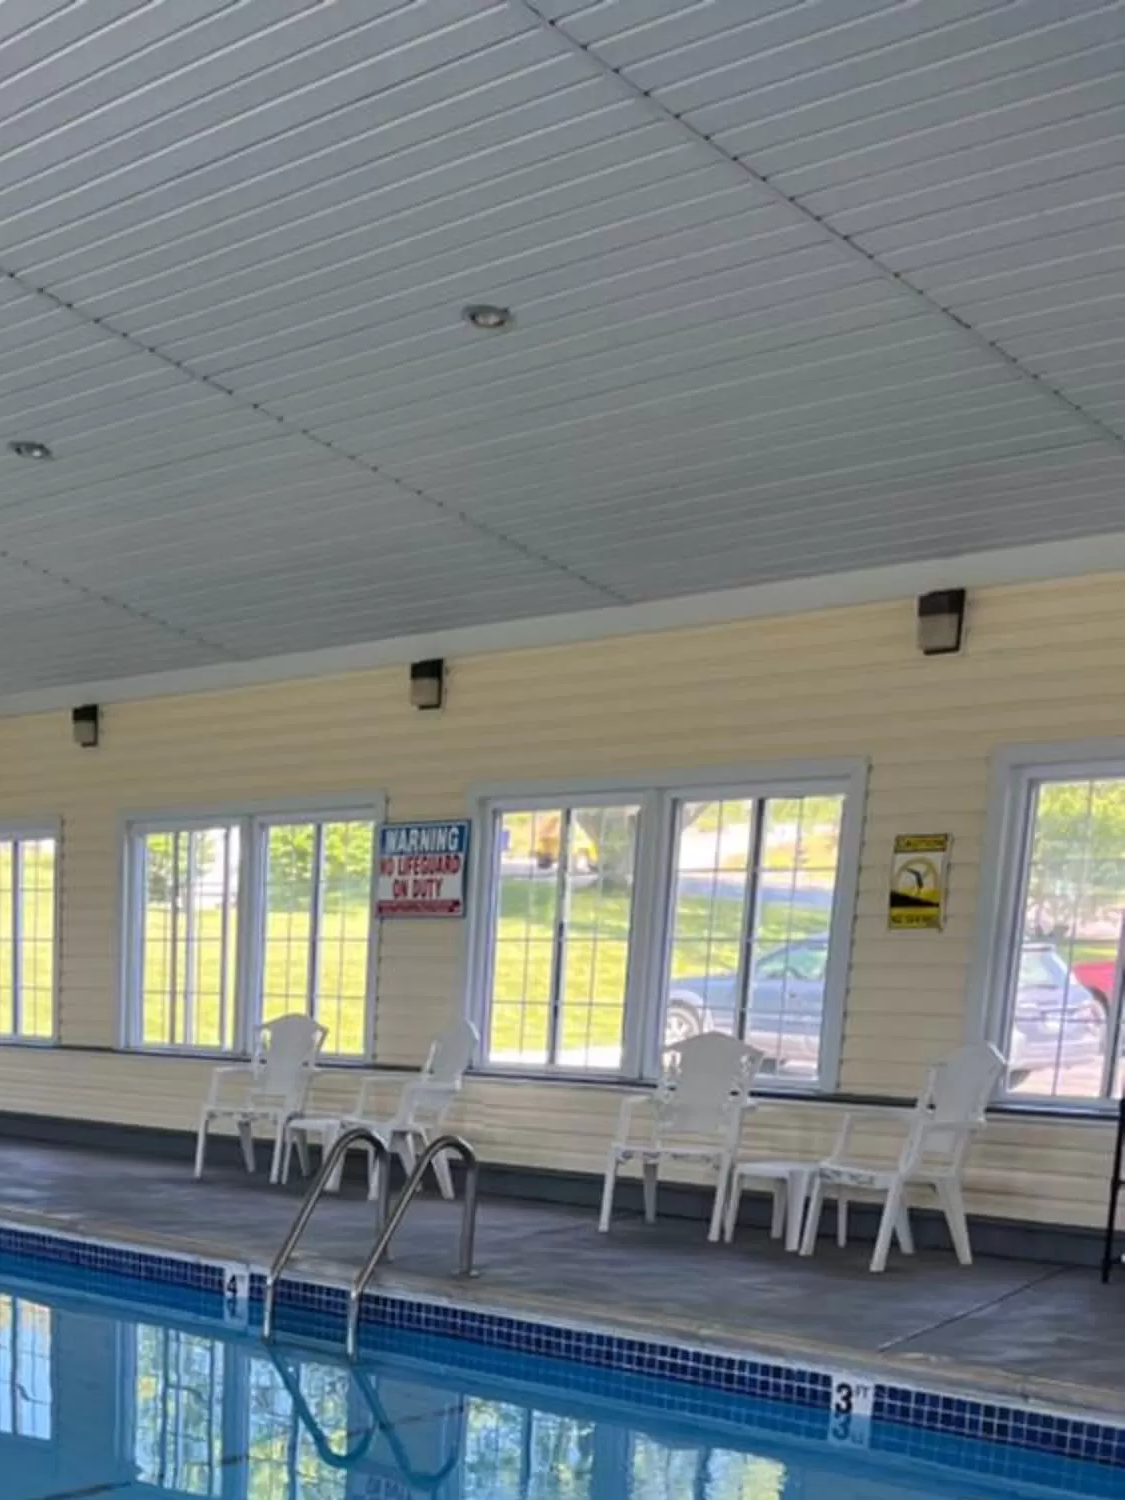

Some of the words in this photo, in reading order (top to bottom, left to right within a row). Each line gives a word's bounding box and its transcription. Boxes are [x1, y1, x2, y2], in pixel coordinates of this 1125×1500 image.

[385, 827, 460, 853] WARNING
[379, 857, 394, 875] NO
[398, 853, 460, 876] LIFEGUARD
[392, 878, 408, 897] ON
[412, 877, 443, 897] DUTY
[226, 1274, 237, 1296] 4
[835, 1382, 853, 1413] 3
